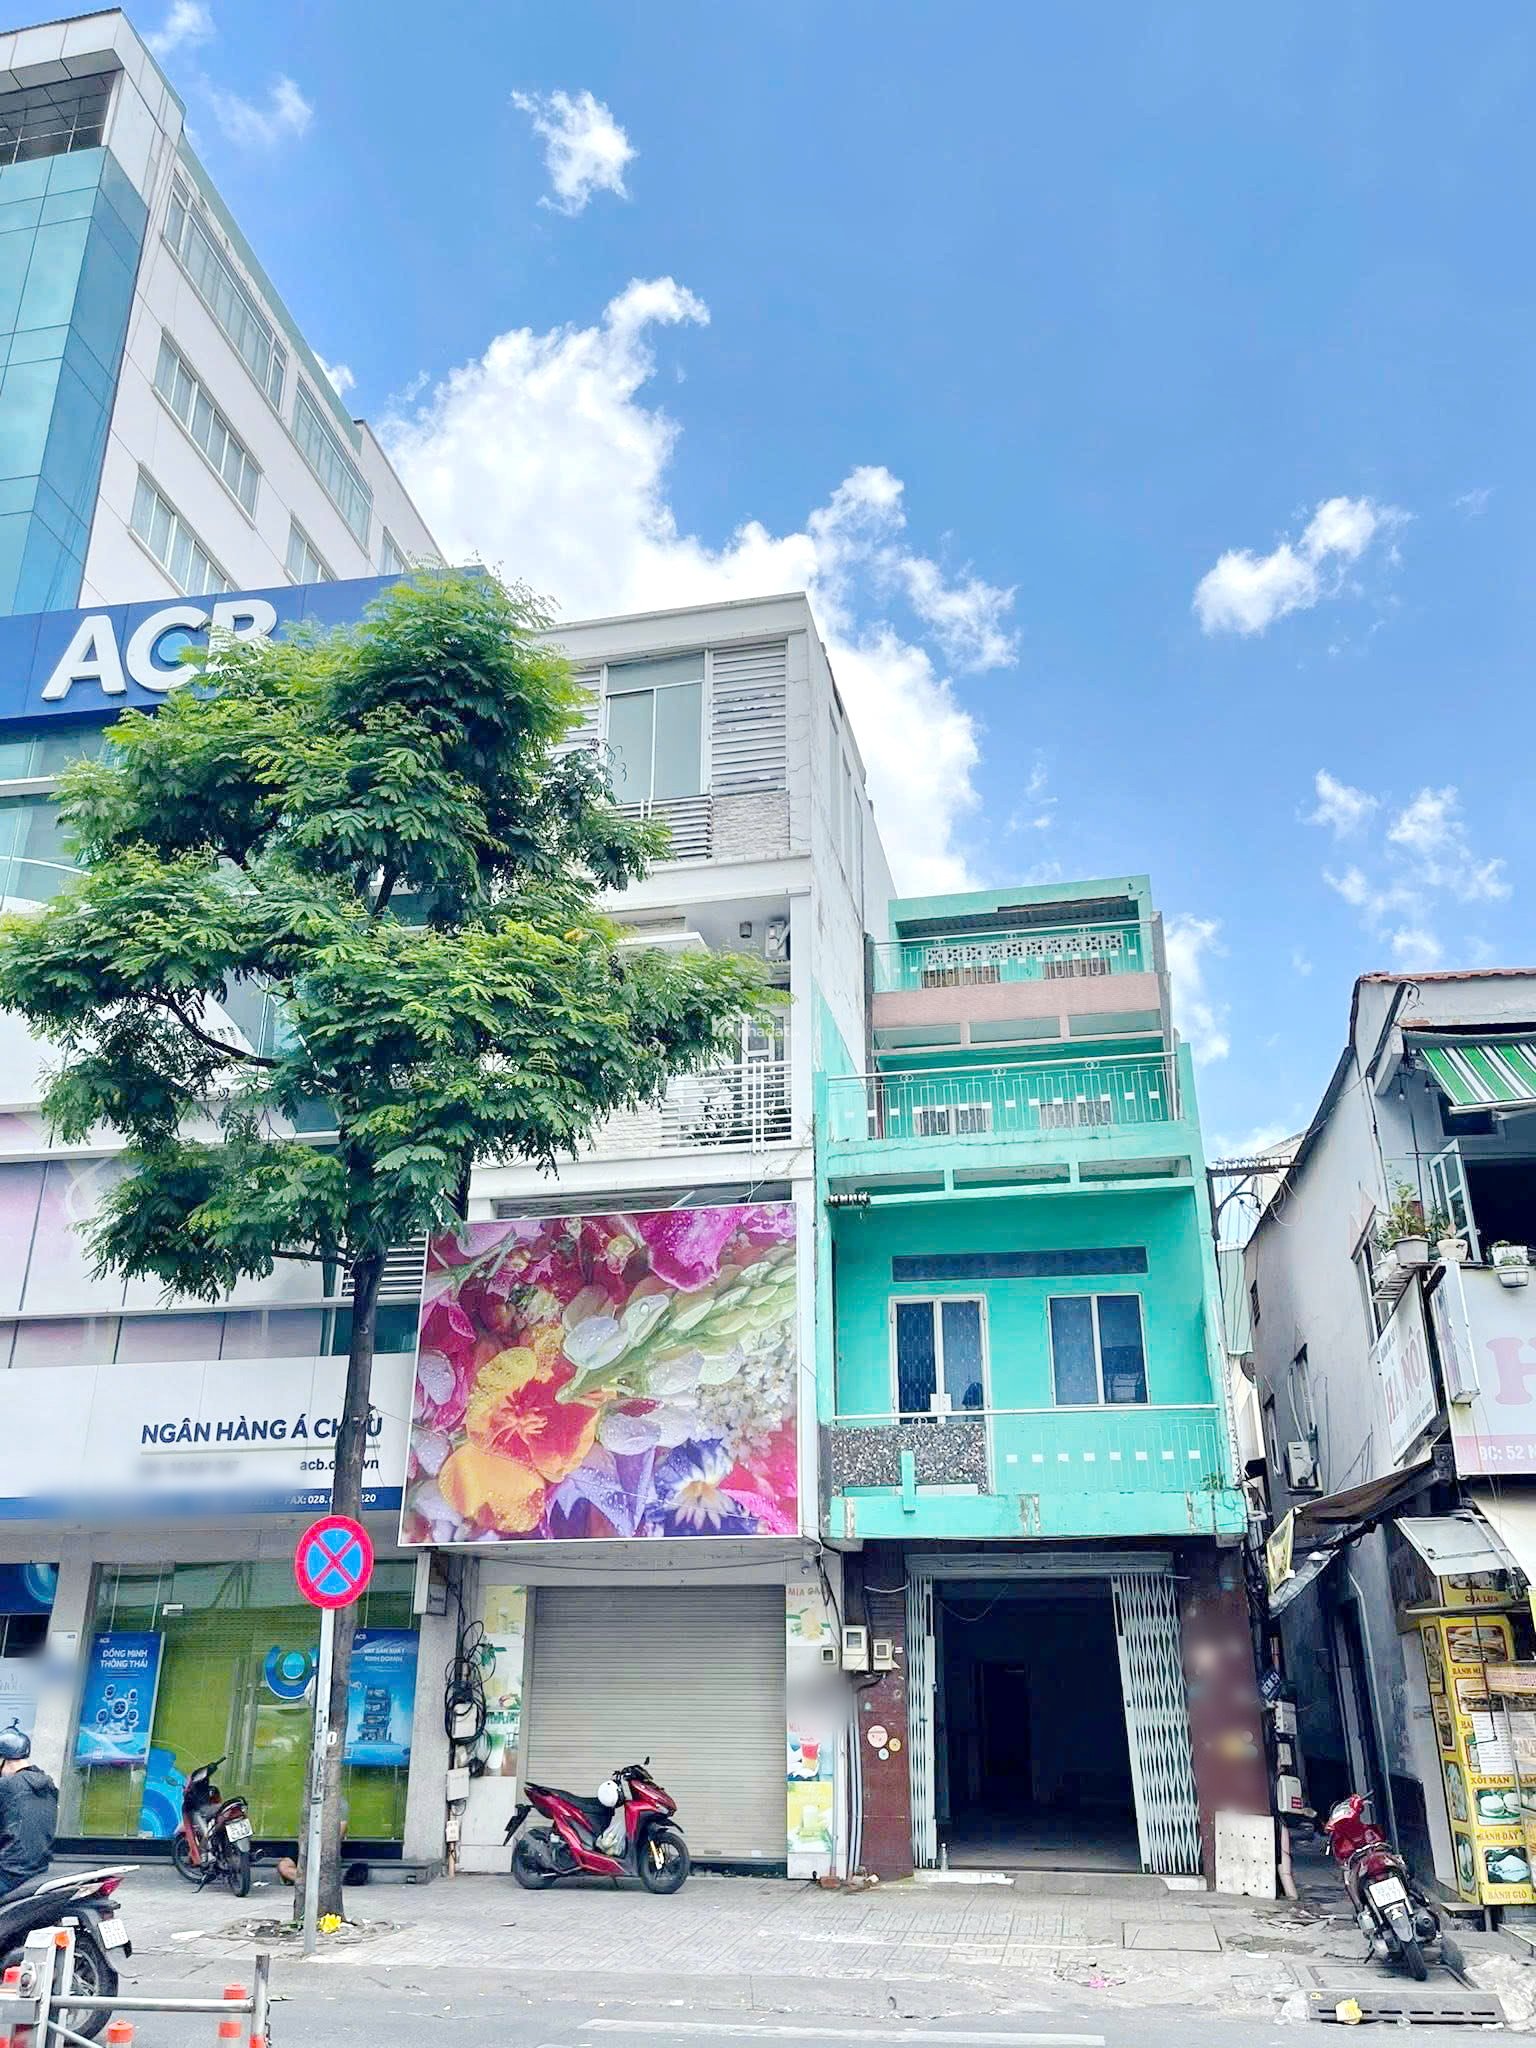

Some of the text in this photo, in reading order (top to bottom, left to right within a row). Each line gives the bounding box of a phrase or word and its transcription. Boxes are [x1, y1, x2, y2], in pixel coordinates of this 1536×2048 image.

[141, 1418, 211, 1444] NGÂN
[216, 1416, 287, 1441] HÀNG
[291, 1414, 308, 1439] Á
[1506, 1445, 1525, 1460] 52
